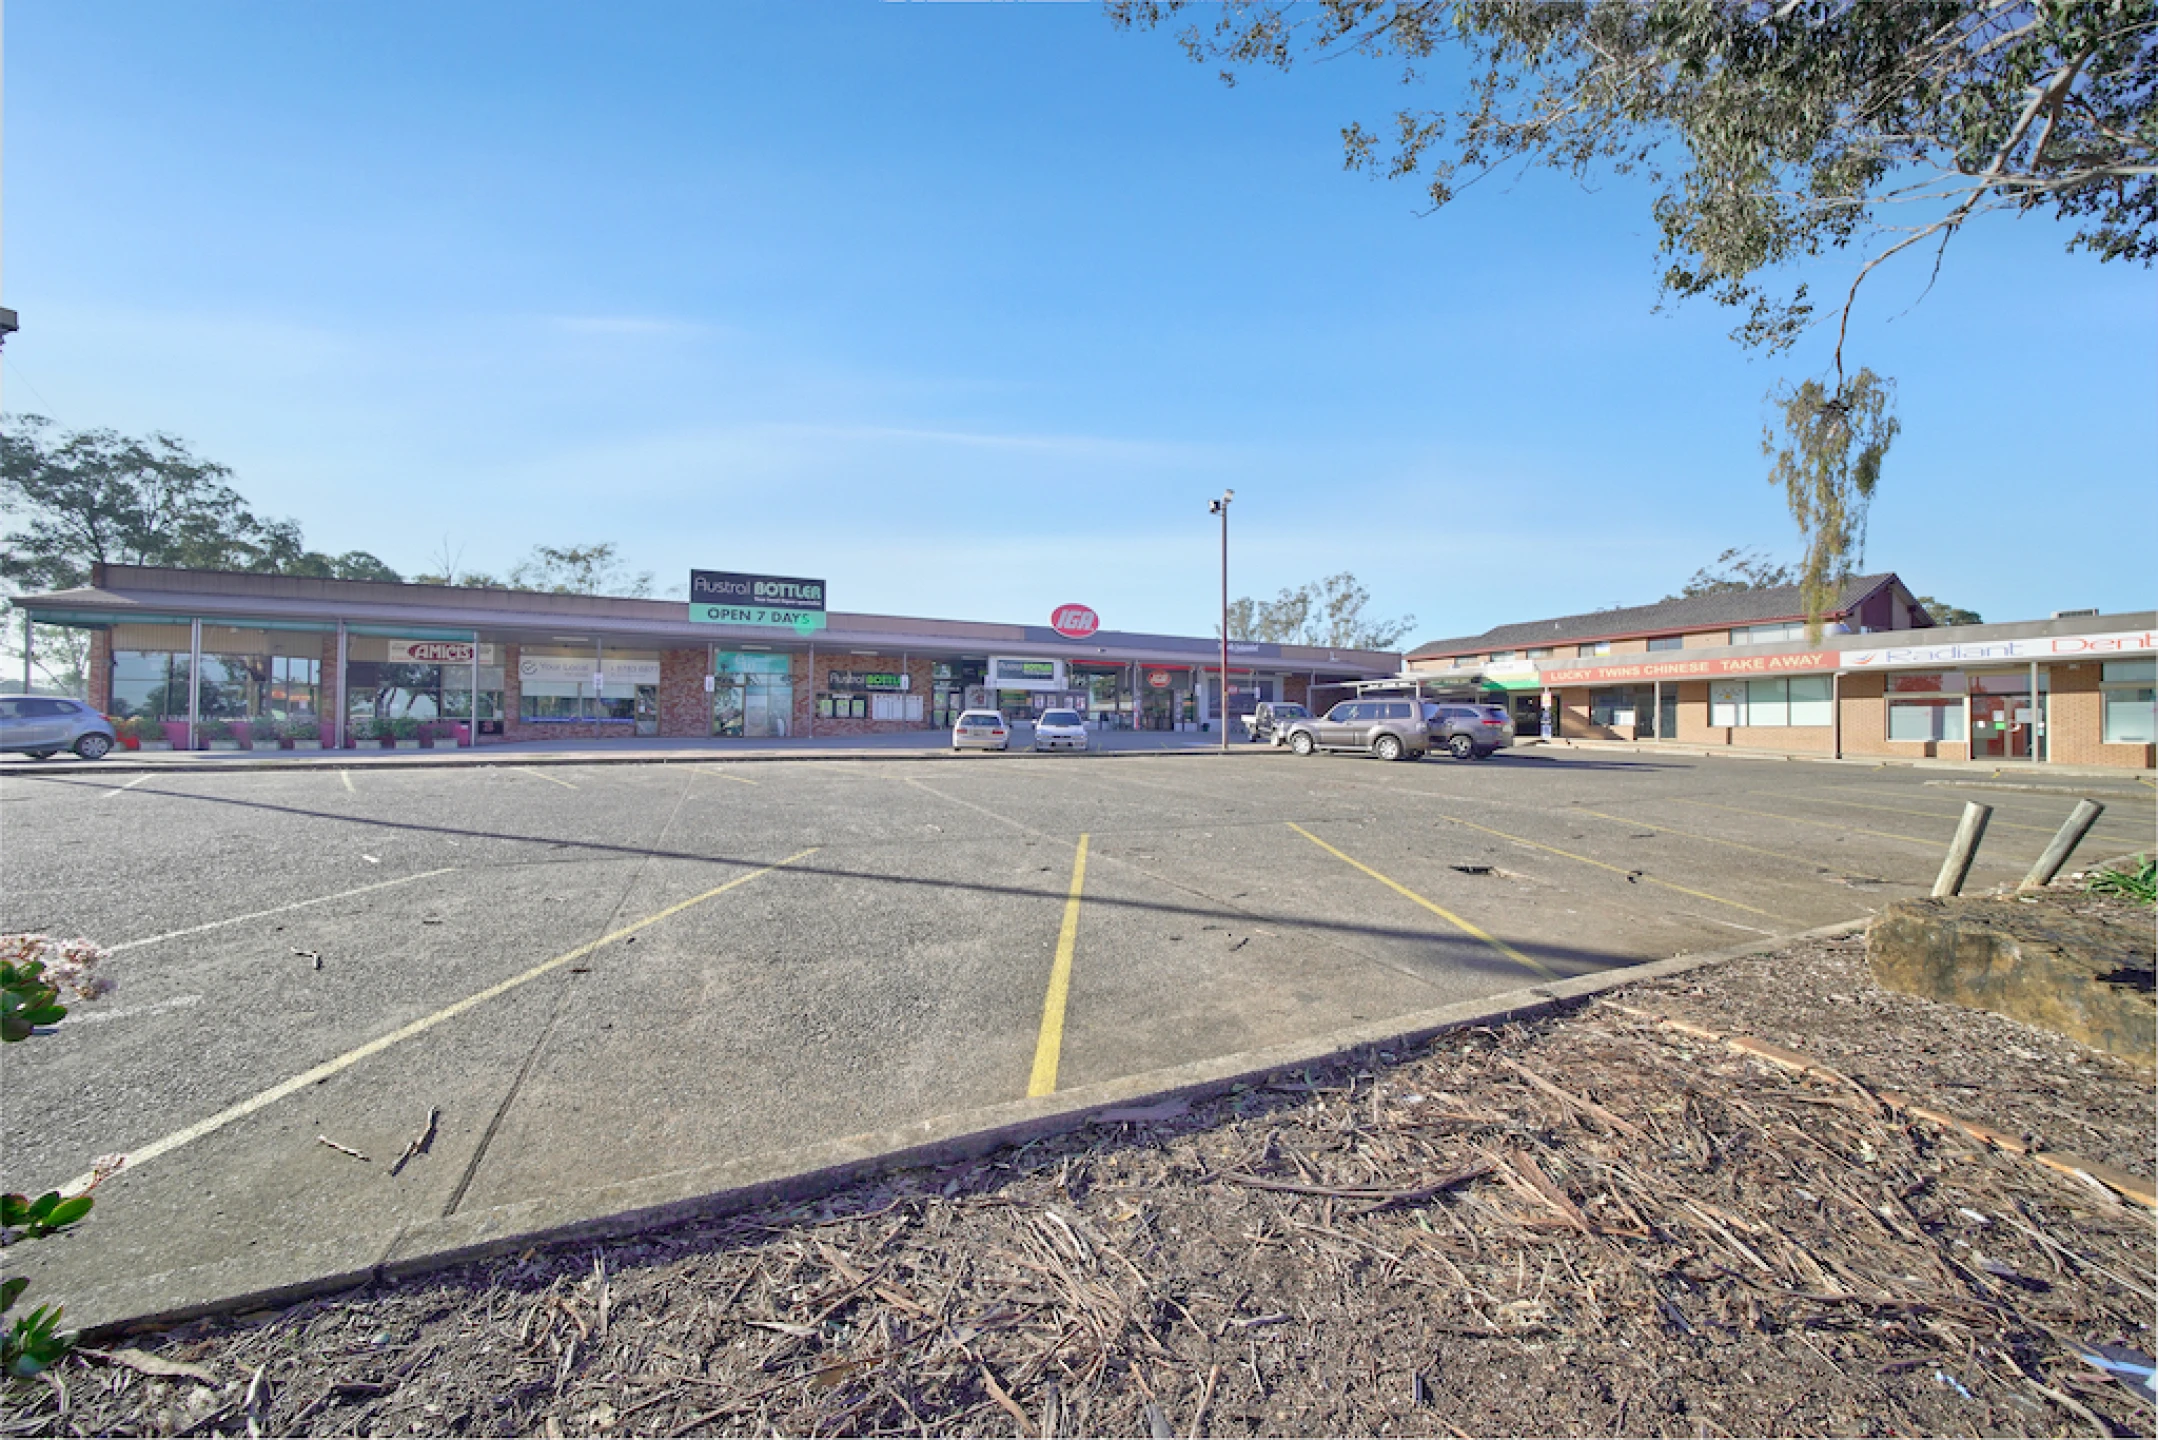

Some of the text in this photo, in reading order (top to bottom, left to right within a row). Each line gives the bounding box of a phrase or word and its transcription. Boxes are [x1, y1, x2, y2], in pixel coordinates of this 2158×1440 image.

[694, 576, 821, 600] Austral BOTTLER
[707, 606, 810, 625] OPEN 7 DAYS
[1057, 609, 1095, 630] IGA
[1885, 642, 2024, 663] Radiant
[1550, 653, 1823, 682] LUCKY TWINS CHINESE TAKE AWAY
